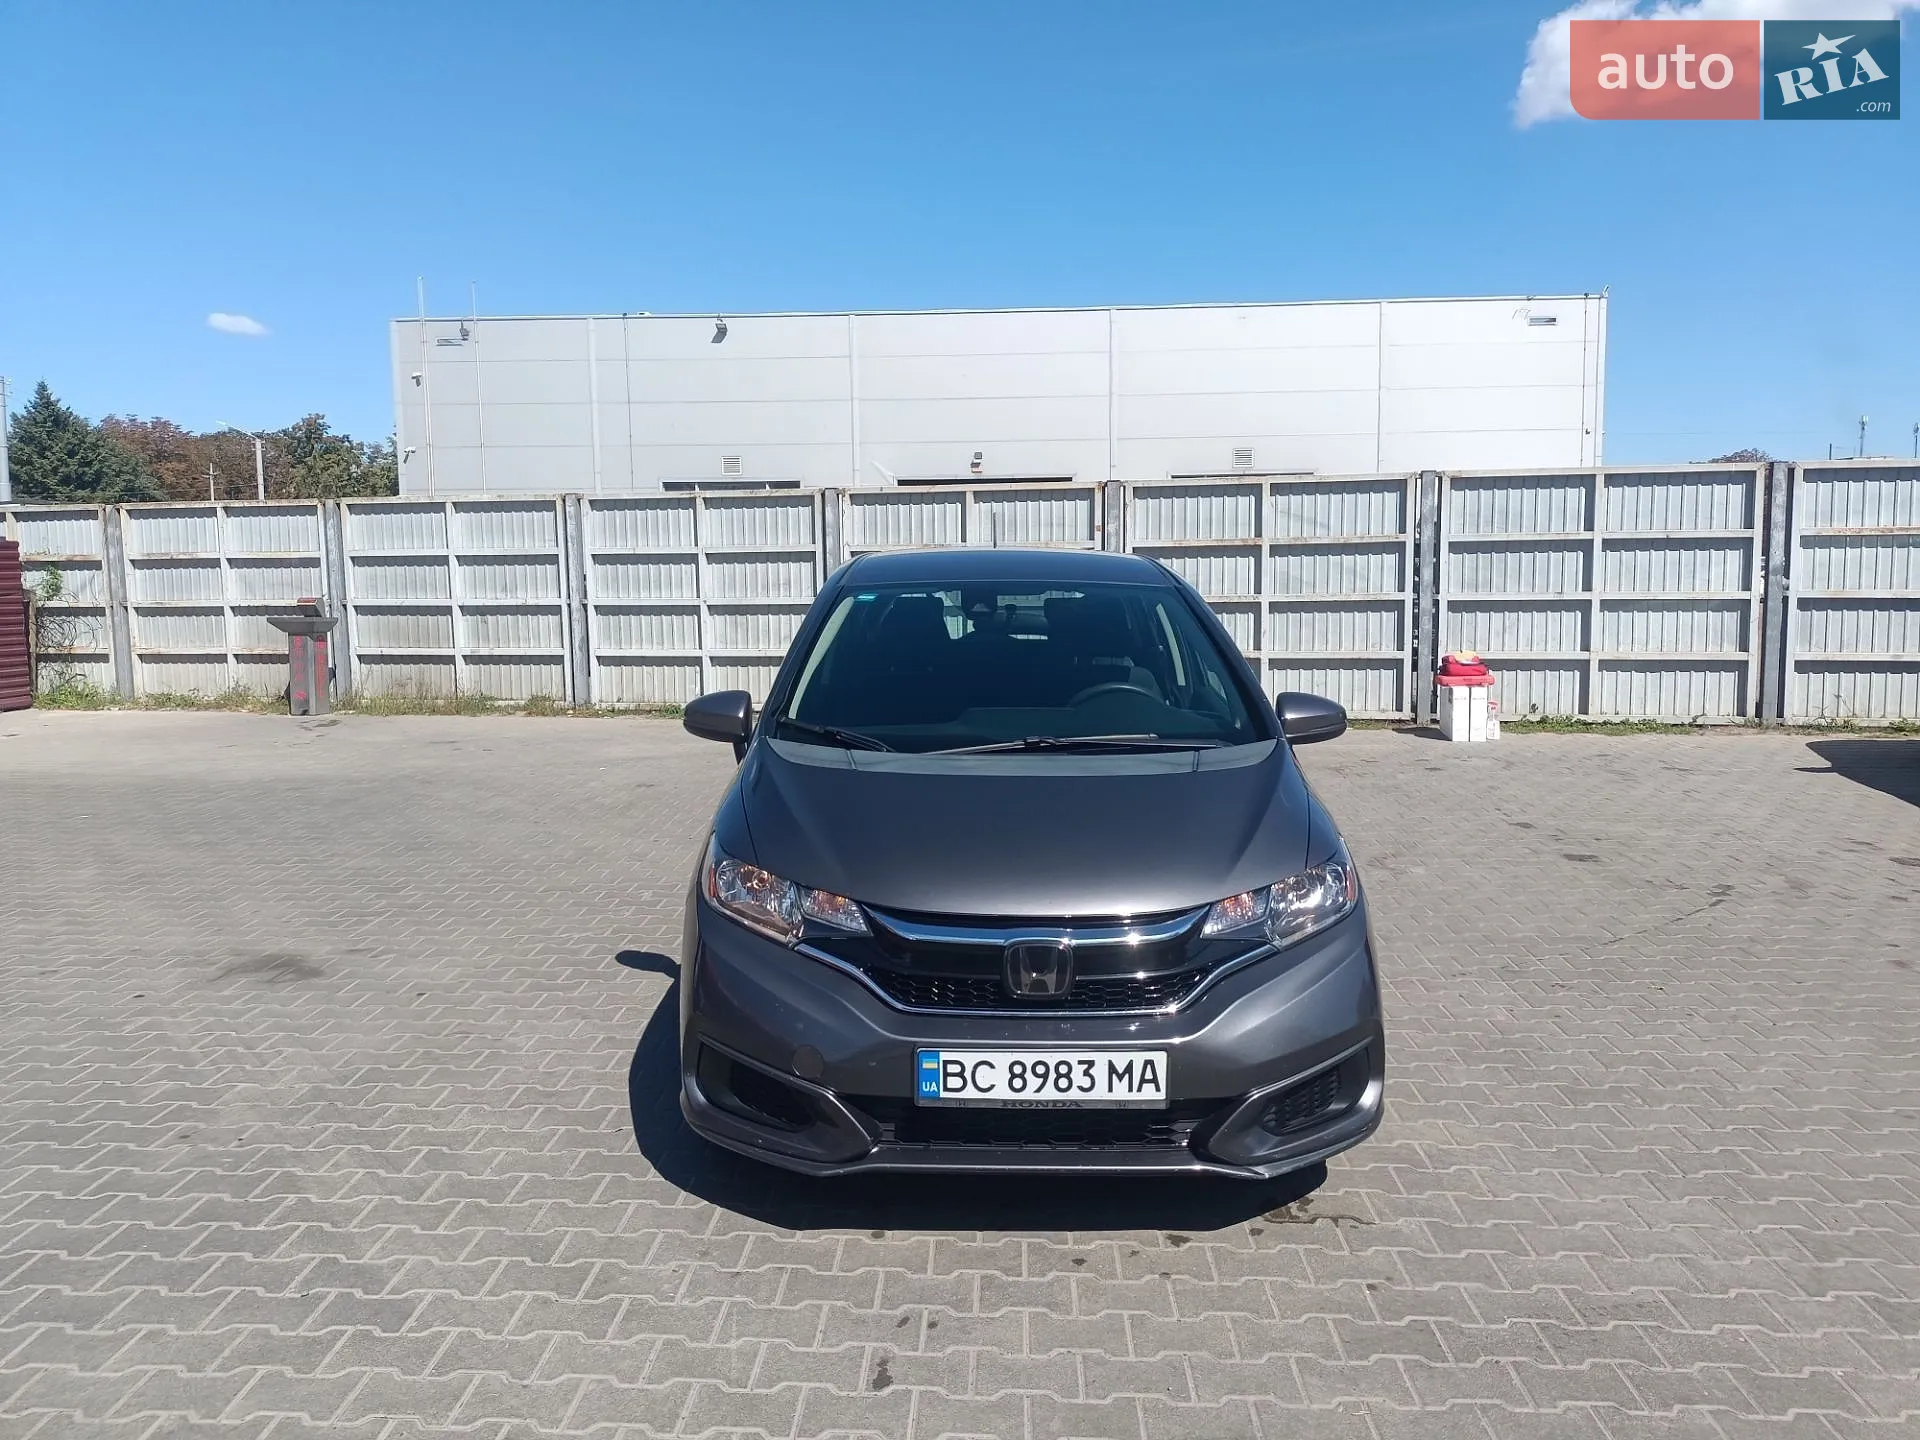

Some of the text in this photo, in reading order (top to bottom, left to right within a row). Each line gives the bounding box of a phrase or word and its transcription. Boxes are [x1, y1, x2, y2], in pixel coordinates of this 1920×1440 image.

[941, 1059, 1161, 1094] BC 8983 MA
[922, 1082, 938, 1093] UA
[1001, 1100, 1084, 1108] HONDA
